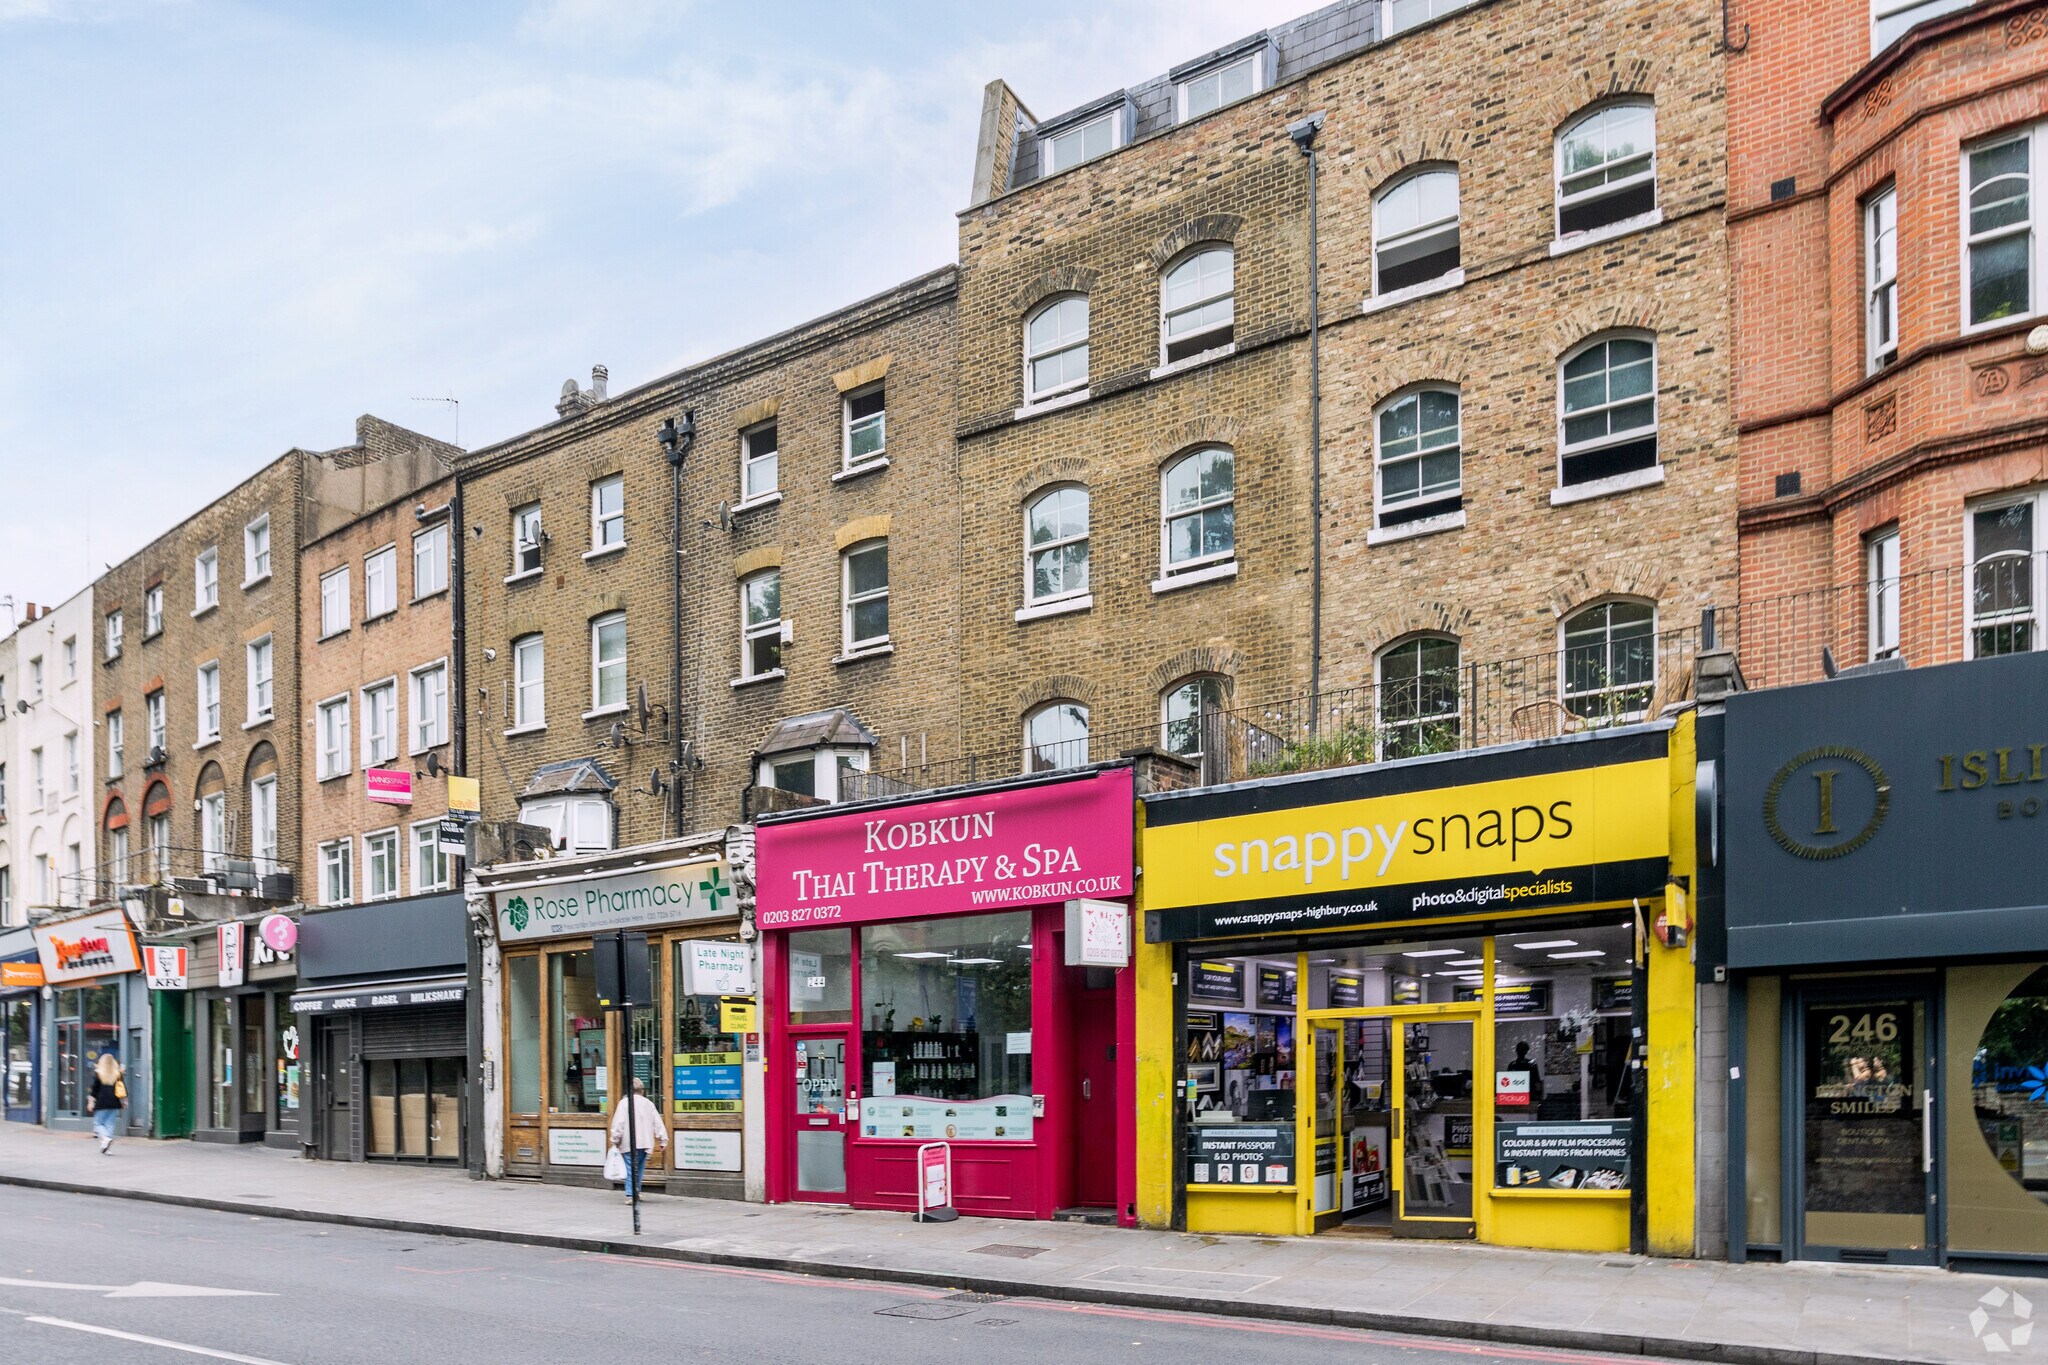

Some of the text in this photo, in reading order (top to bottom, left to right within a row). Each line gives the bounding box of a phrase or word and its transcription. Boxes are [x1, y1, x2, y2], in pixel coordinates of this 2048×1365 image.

[1937, 743, 2048, 792] ISLI
[450, 799, 477, 809] savills
[864, 811, 996, 854] KOBKUN
[792, 843, 1082, 901] THAI THERAPY & SPA
[971, 875, 1122, 905] WWW.KOBKUN.CO.UK
[533, 880, 694, 921] Rose Pharmacy
[762, 904, 843, 925] 0203 827 0372
[1214, 900, 1379, 927] www.snappysnaps-highbury.co.uk
[697, 947, 745, 961] Late Night
[698, 959, 745, 974] Pharmacy
[155, 978, 182, 988] KFC
[809, 977, 824, 987] 244
[293, 989, 462, 1012] COFFEE JUICE BAGEL MILKSHAKE
[1828, 1013, 1898, 1043] 246
[801, 1078, 838, 1092] OPEN
[1512, 1078, 1526, 1087] dpd
[1499, 1094, 1526, 1103] Pickup
[1830, 1100, 1897, 1115] SMILES
[1202, 1141, 1277, 1150] INSTANT PASSPORT
[1502, 1139, 1534, 1148] COLOUR
[1557, 1138, 1576, 1147] FILM
[1576, 1138, 1626, 1147] PROCESSING
[1213, 1152, 1265, 1161] & ID PHOTOS
[1503, 1148, 1627, 1157] & INSTANT PRINTS FROM PHONES
